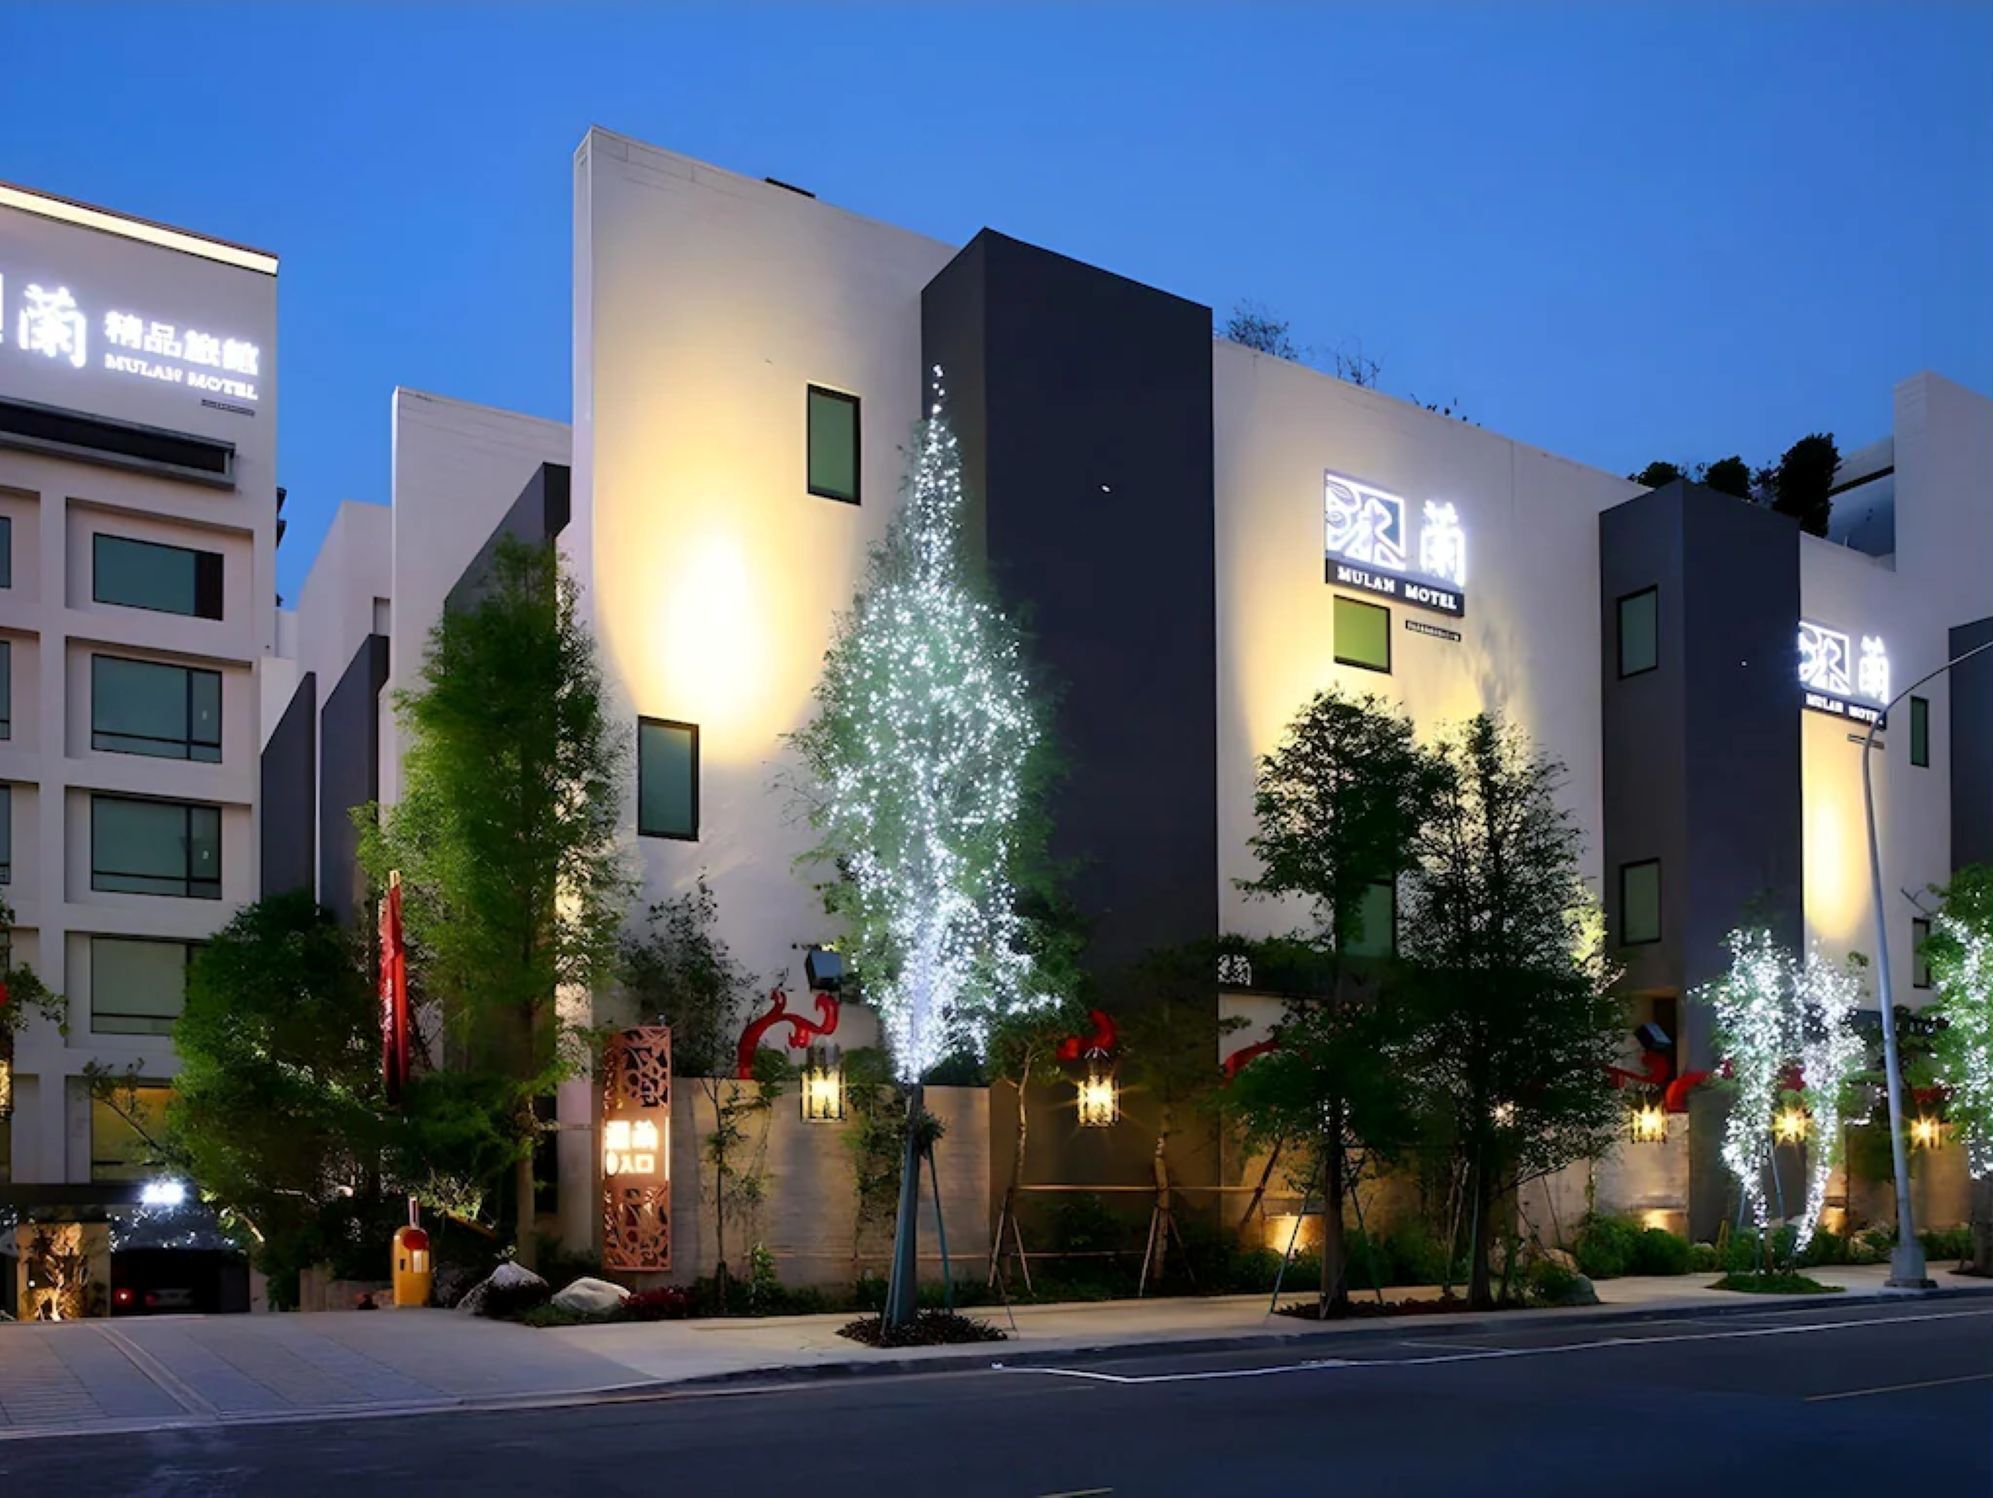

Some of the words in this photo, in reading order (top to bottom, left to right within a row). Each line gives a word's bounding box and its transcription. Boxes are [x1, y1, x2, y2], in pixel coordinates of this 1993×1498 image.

[104, 353, 183, 383] MULAN
[187, 370, 259, 400] MOTEL
[1337, 566, 1395, 594] MULAN
[1405, 583, 1457, 610] MOTEL
